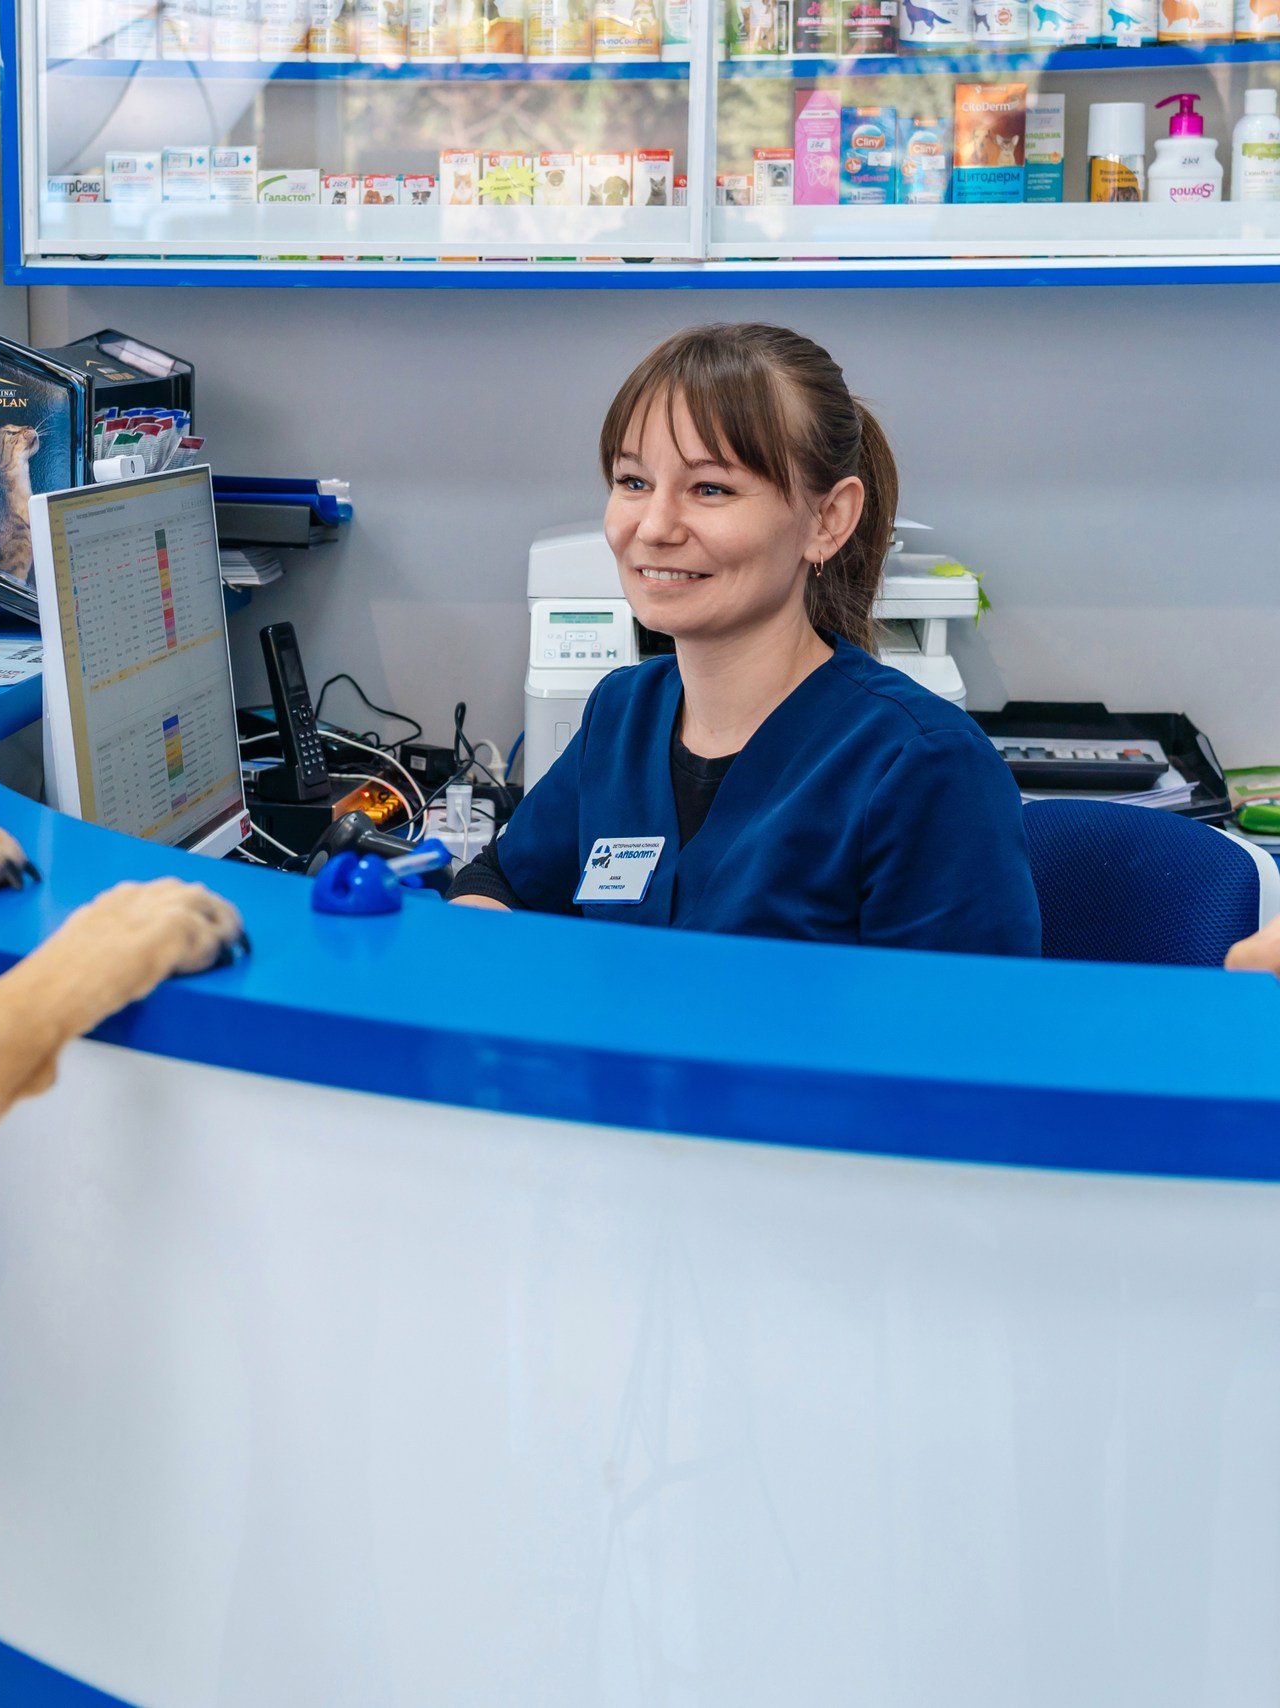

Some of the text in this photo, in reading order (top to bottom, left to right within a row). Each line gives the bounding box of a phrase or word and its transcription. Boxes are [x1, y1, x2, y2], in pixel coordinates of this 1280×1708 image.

[961, 102, 1010, 112] CitoDerm
[855, 137, 880, 147] Cliny
[912, 144, 937, 155] Cliny
[957, 170, 1020, 184] Цитодерм
[264, 193, 311, 203] Галастоп
